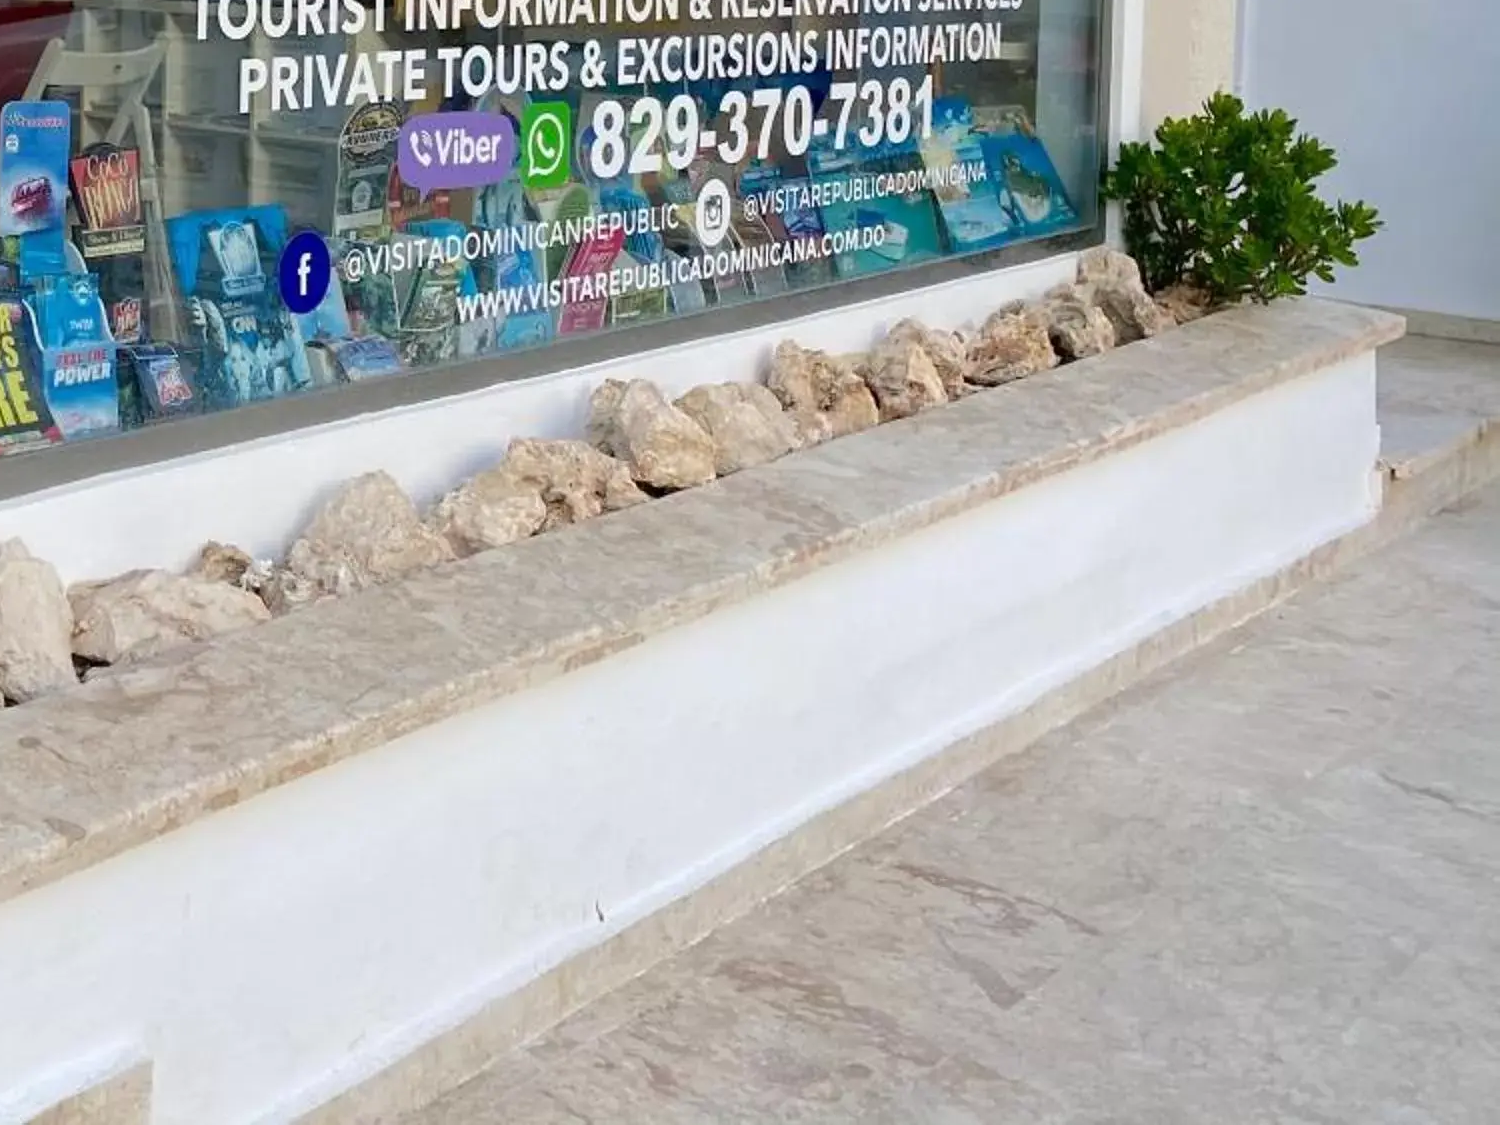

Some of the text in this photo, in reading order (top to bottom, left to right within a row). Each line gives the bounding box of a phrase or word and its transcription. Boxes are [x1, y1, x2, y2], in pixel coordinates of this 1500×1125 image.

[240, 23, 1001, 114] PRIVATE TOURS & EXCURSIONS INFORMATION
[435, 128, 502, 166] Viber
[591, 75, 933, 179] 829-370-7381
[744, 160, 987, 222] @VISITAREPUBLICADOMINICANA
[345, 204, 679, 283] @VISITADOMINICANREPUBLIC
[457, 225, 885, 322] WWW.VISITAREPUBLICADOMINICANA.COM.DO
[53, 362, 112, 388] POWER
